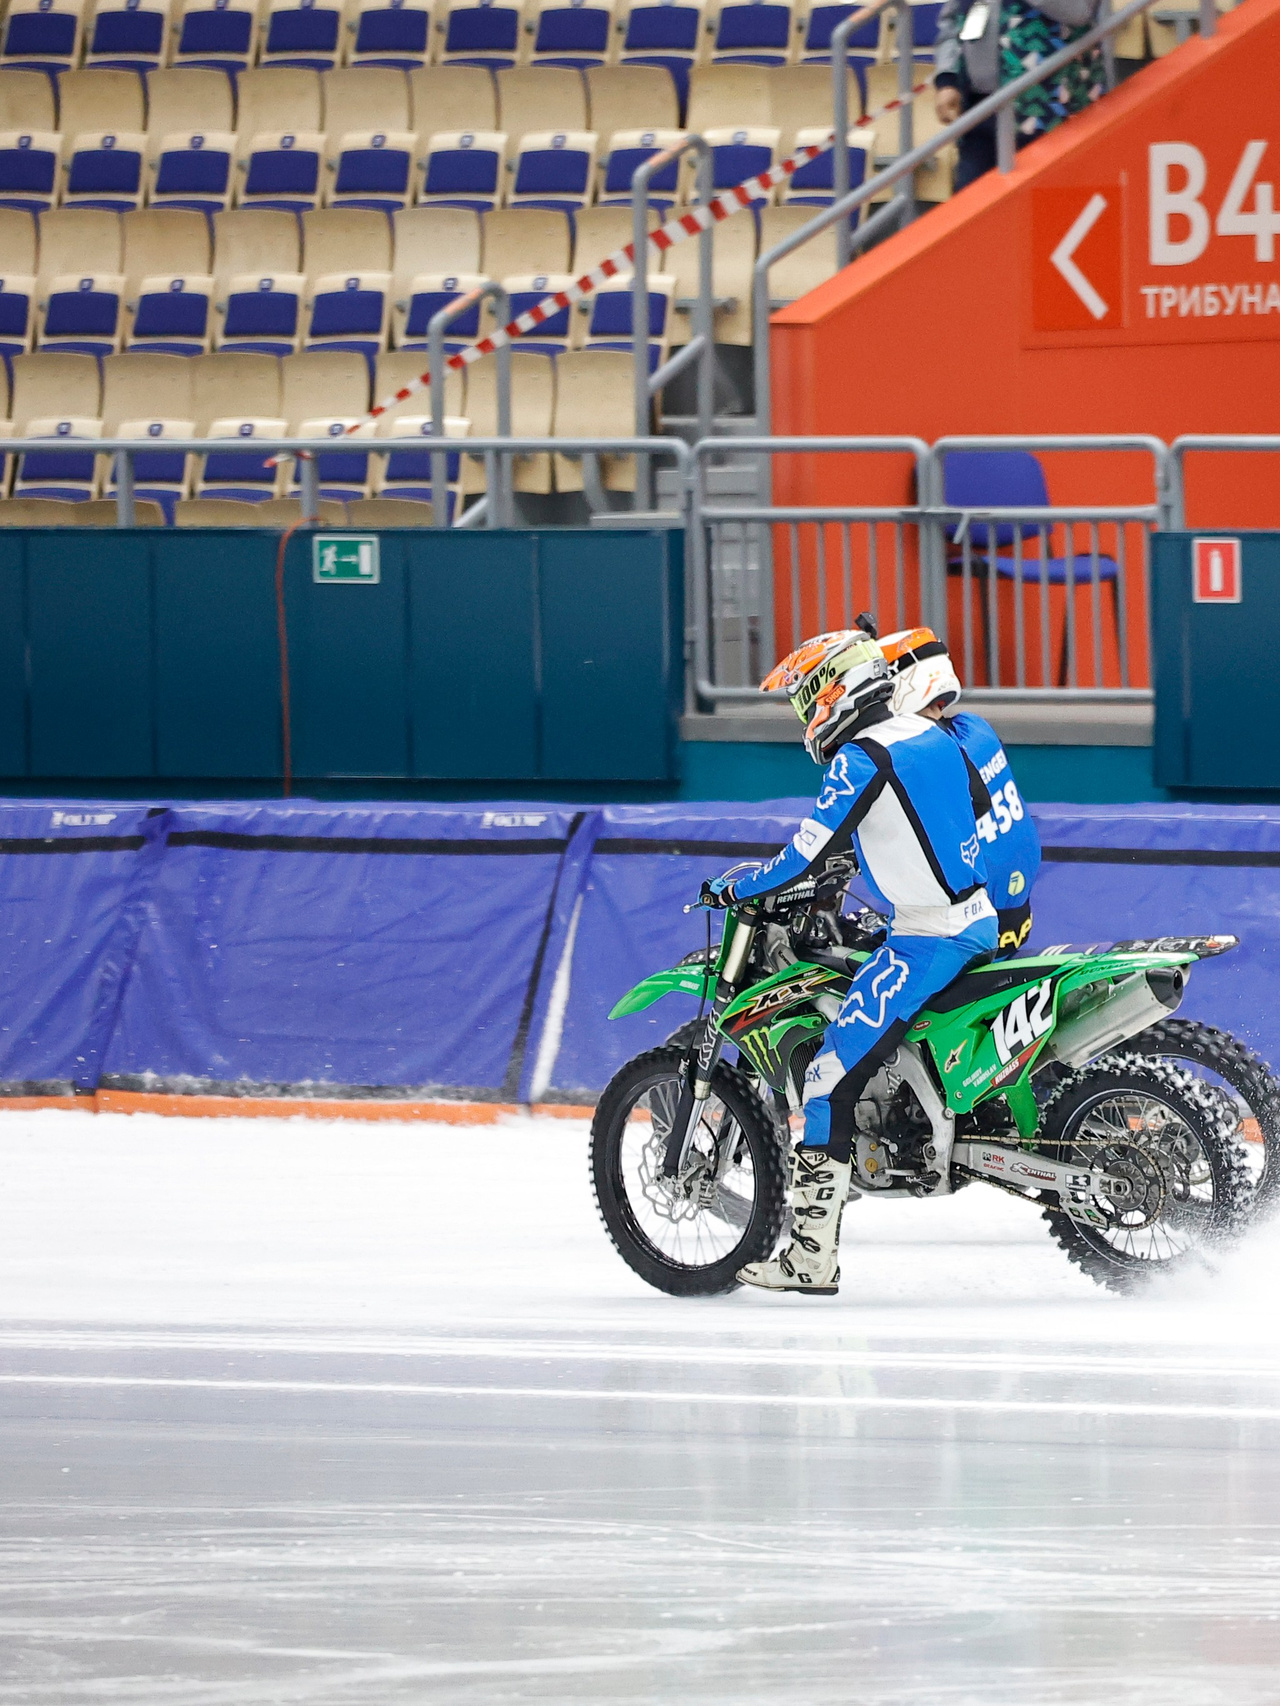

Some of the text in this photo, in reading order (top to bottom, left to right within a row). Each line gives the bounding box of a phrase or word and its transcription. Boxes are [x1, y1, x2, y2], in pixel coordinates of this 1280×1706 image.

[795, 660, 837, 713] 100%
[975, 778, 1025, 844] 458
[776, 889, 816, 905] RENTHAL
[963, 900, 984, 919] FOX
[749, 977, 826, 1015] KX
[989, 978, 1054, 1066] 142
[991, 1154, 1005, 1164] RK
